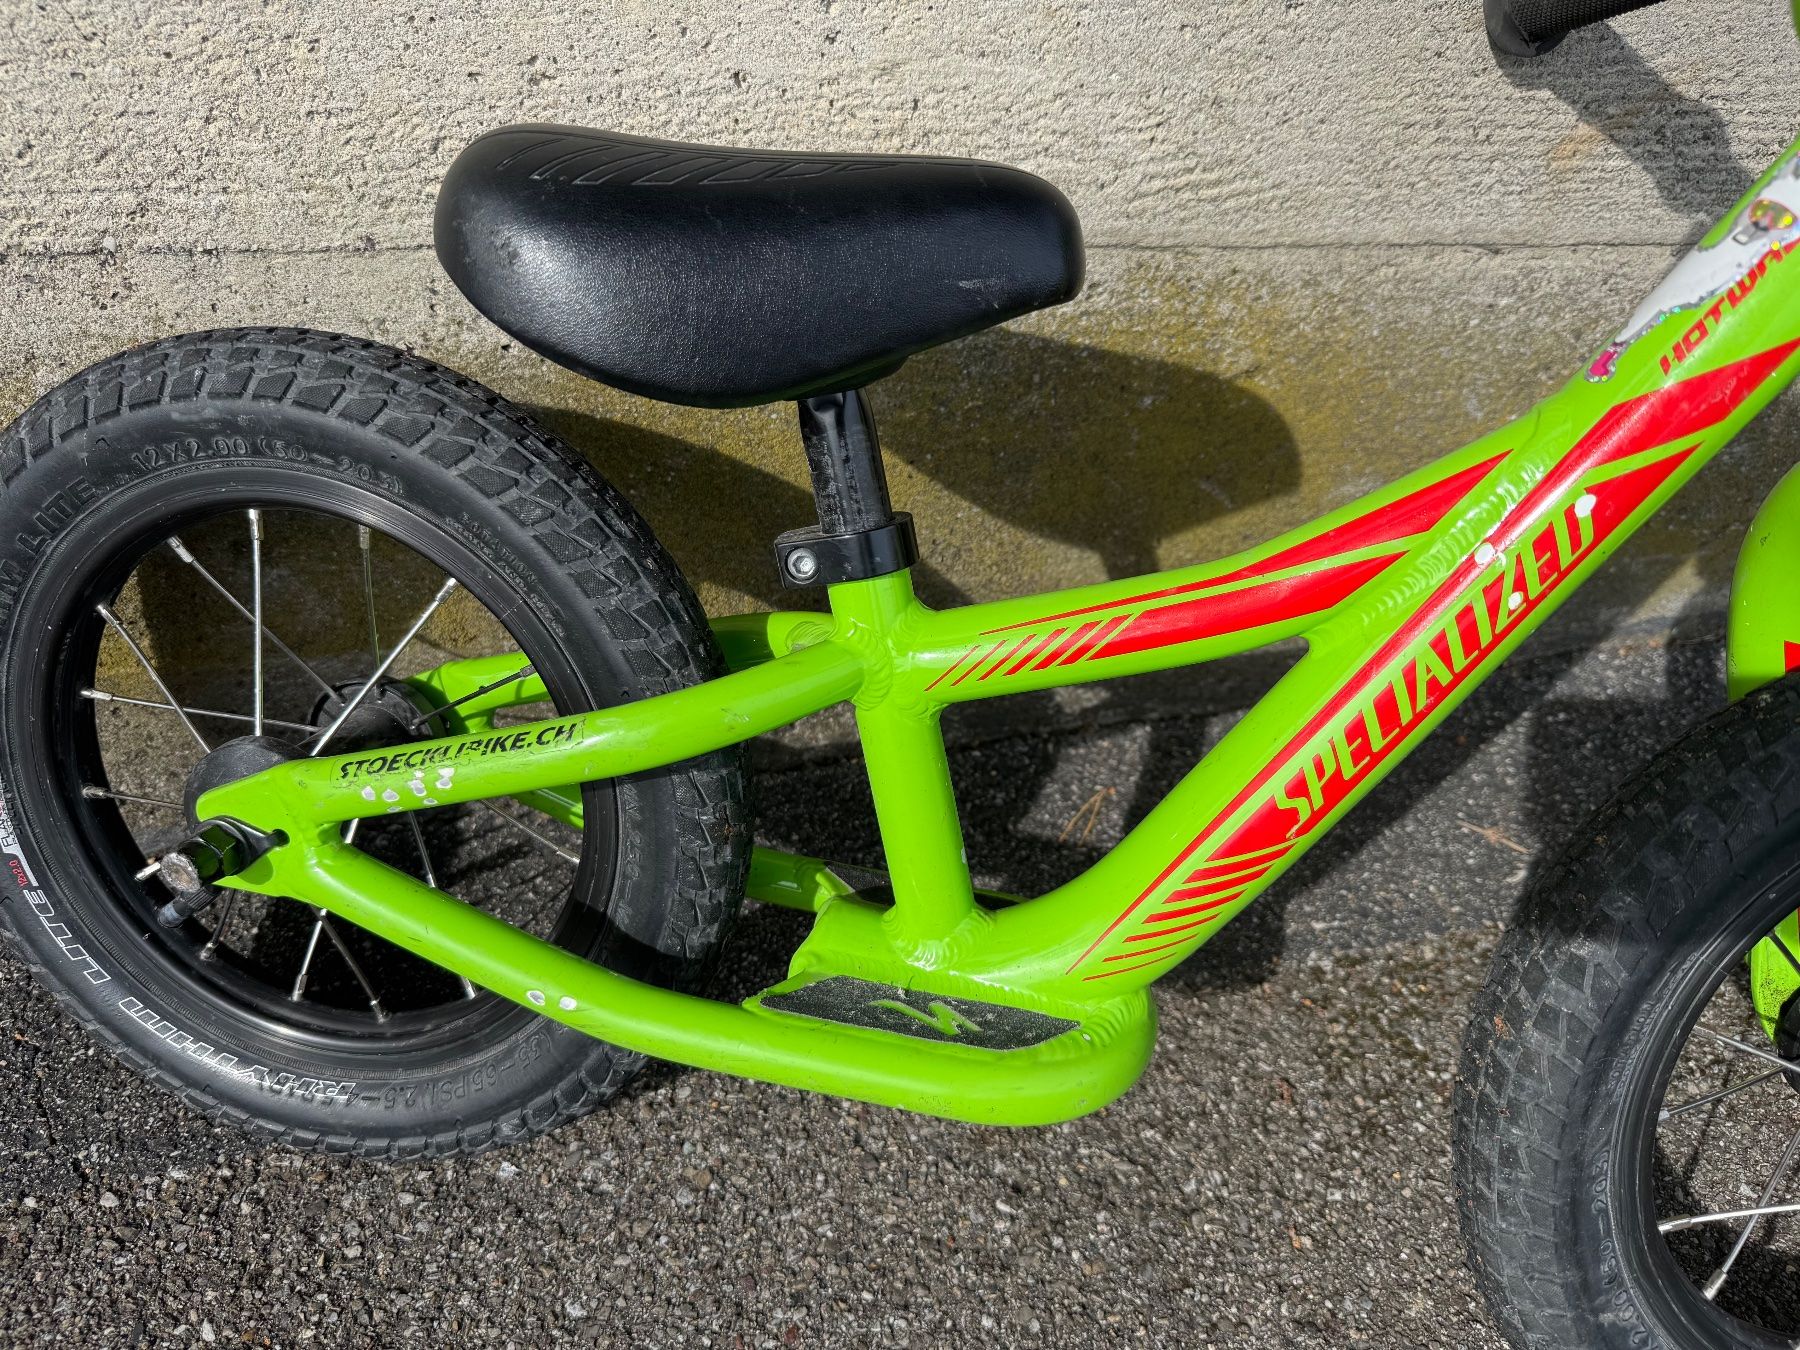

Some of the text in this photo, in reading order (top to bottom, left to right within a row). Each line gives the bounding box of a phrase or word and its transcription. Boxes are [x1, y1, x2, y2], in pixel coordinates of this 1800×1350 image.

[16, 476, 99, 556] LITE
[1274, 487, 1597, 840] SPECIALIZED
[23, 889, 357, 1100] RHYTHM LITE
